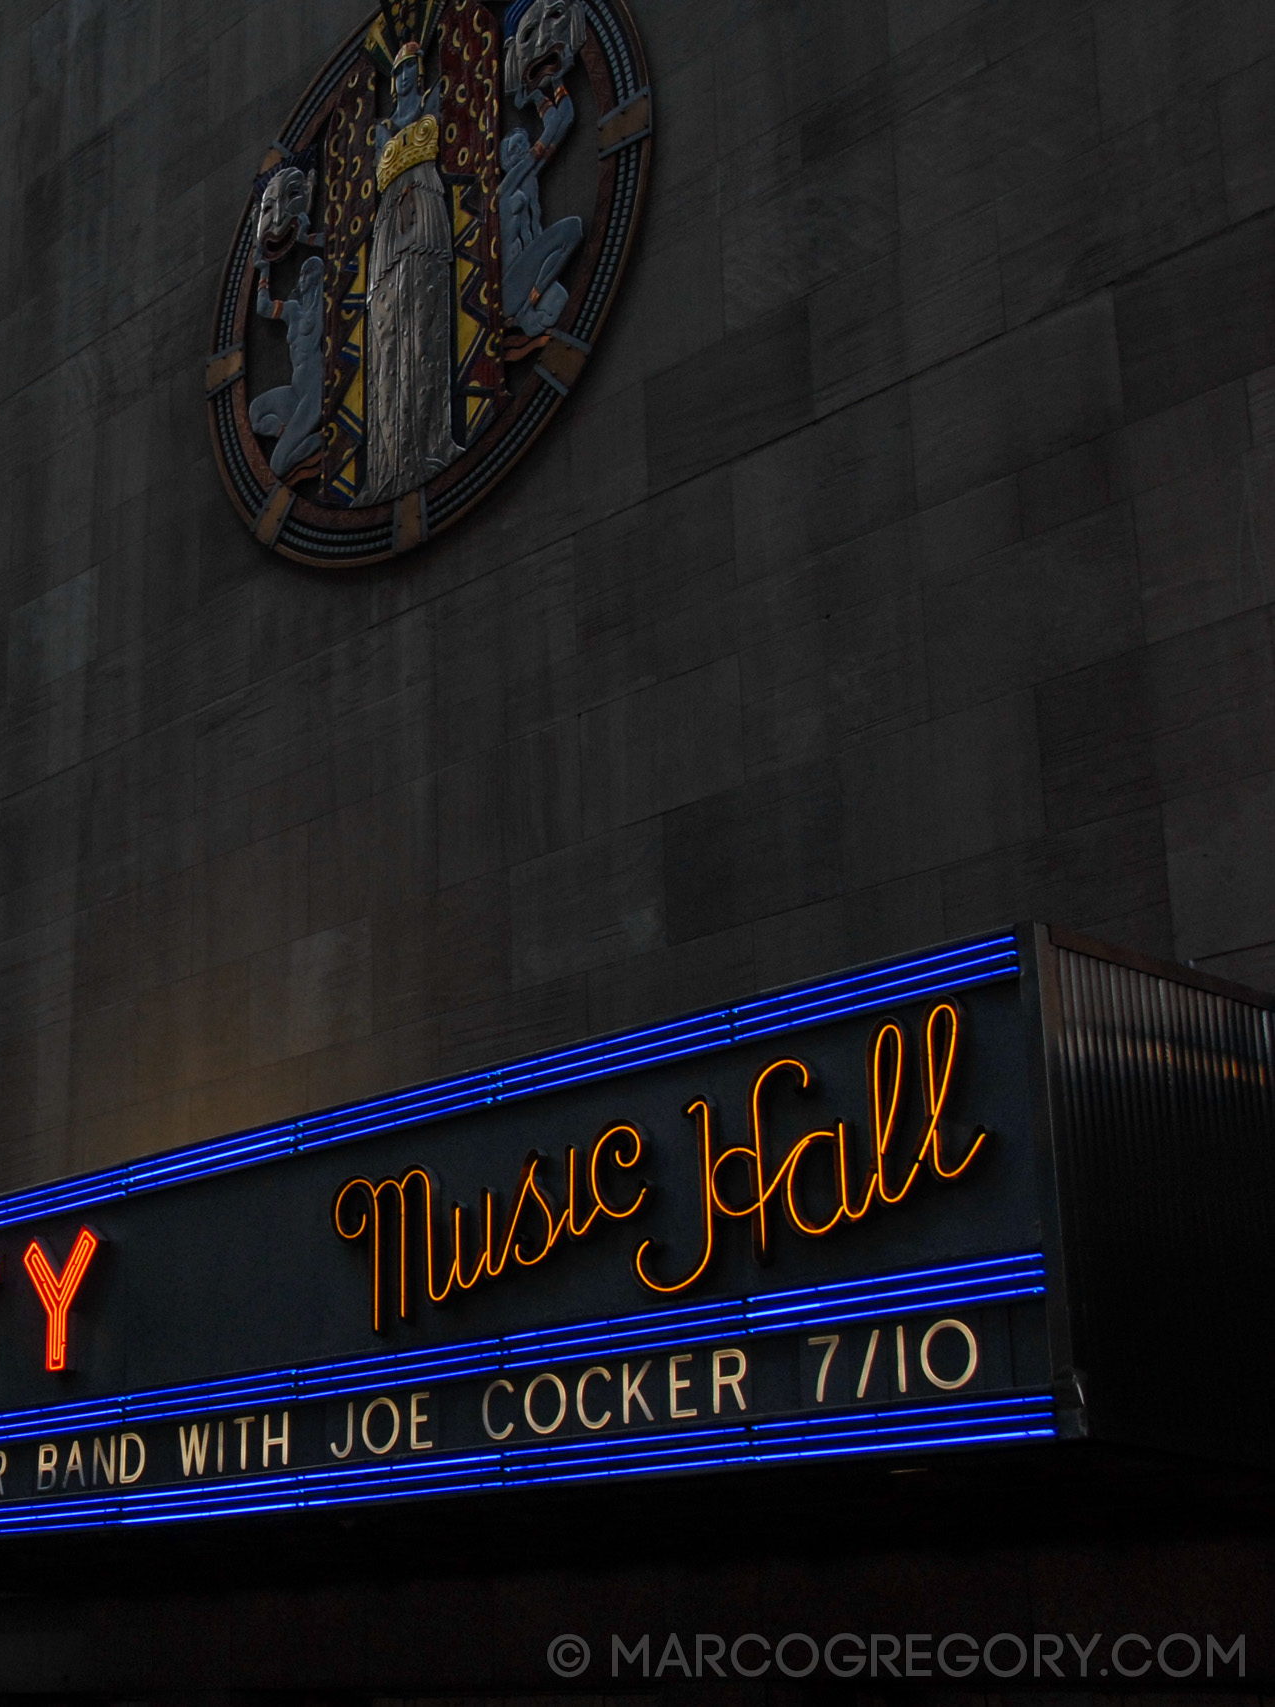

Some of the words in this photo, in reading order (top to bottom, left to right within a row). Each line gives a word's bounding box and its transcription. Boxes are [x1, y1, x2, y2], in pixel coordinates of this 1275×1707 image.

[332, 1123, 651, 1333] Music
[636, 1000, 989, 1293] Hall
[35, 1432, 147, 1492] BAND
[178, 1410, 290, 1478] WITH
[330, 1391, 434, 1460] JOE
[481, 1348, 748, 1441] COCKER
[807, 1318, 979, 1403] 7/10
